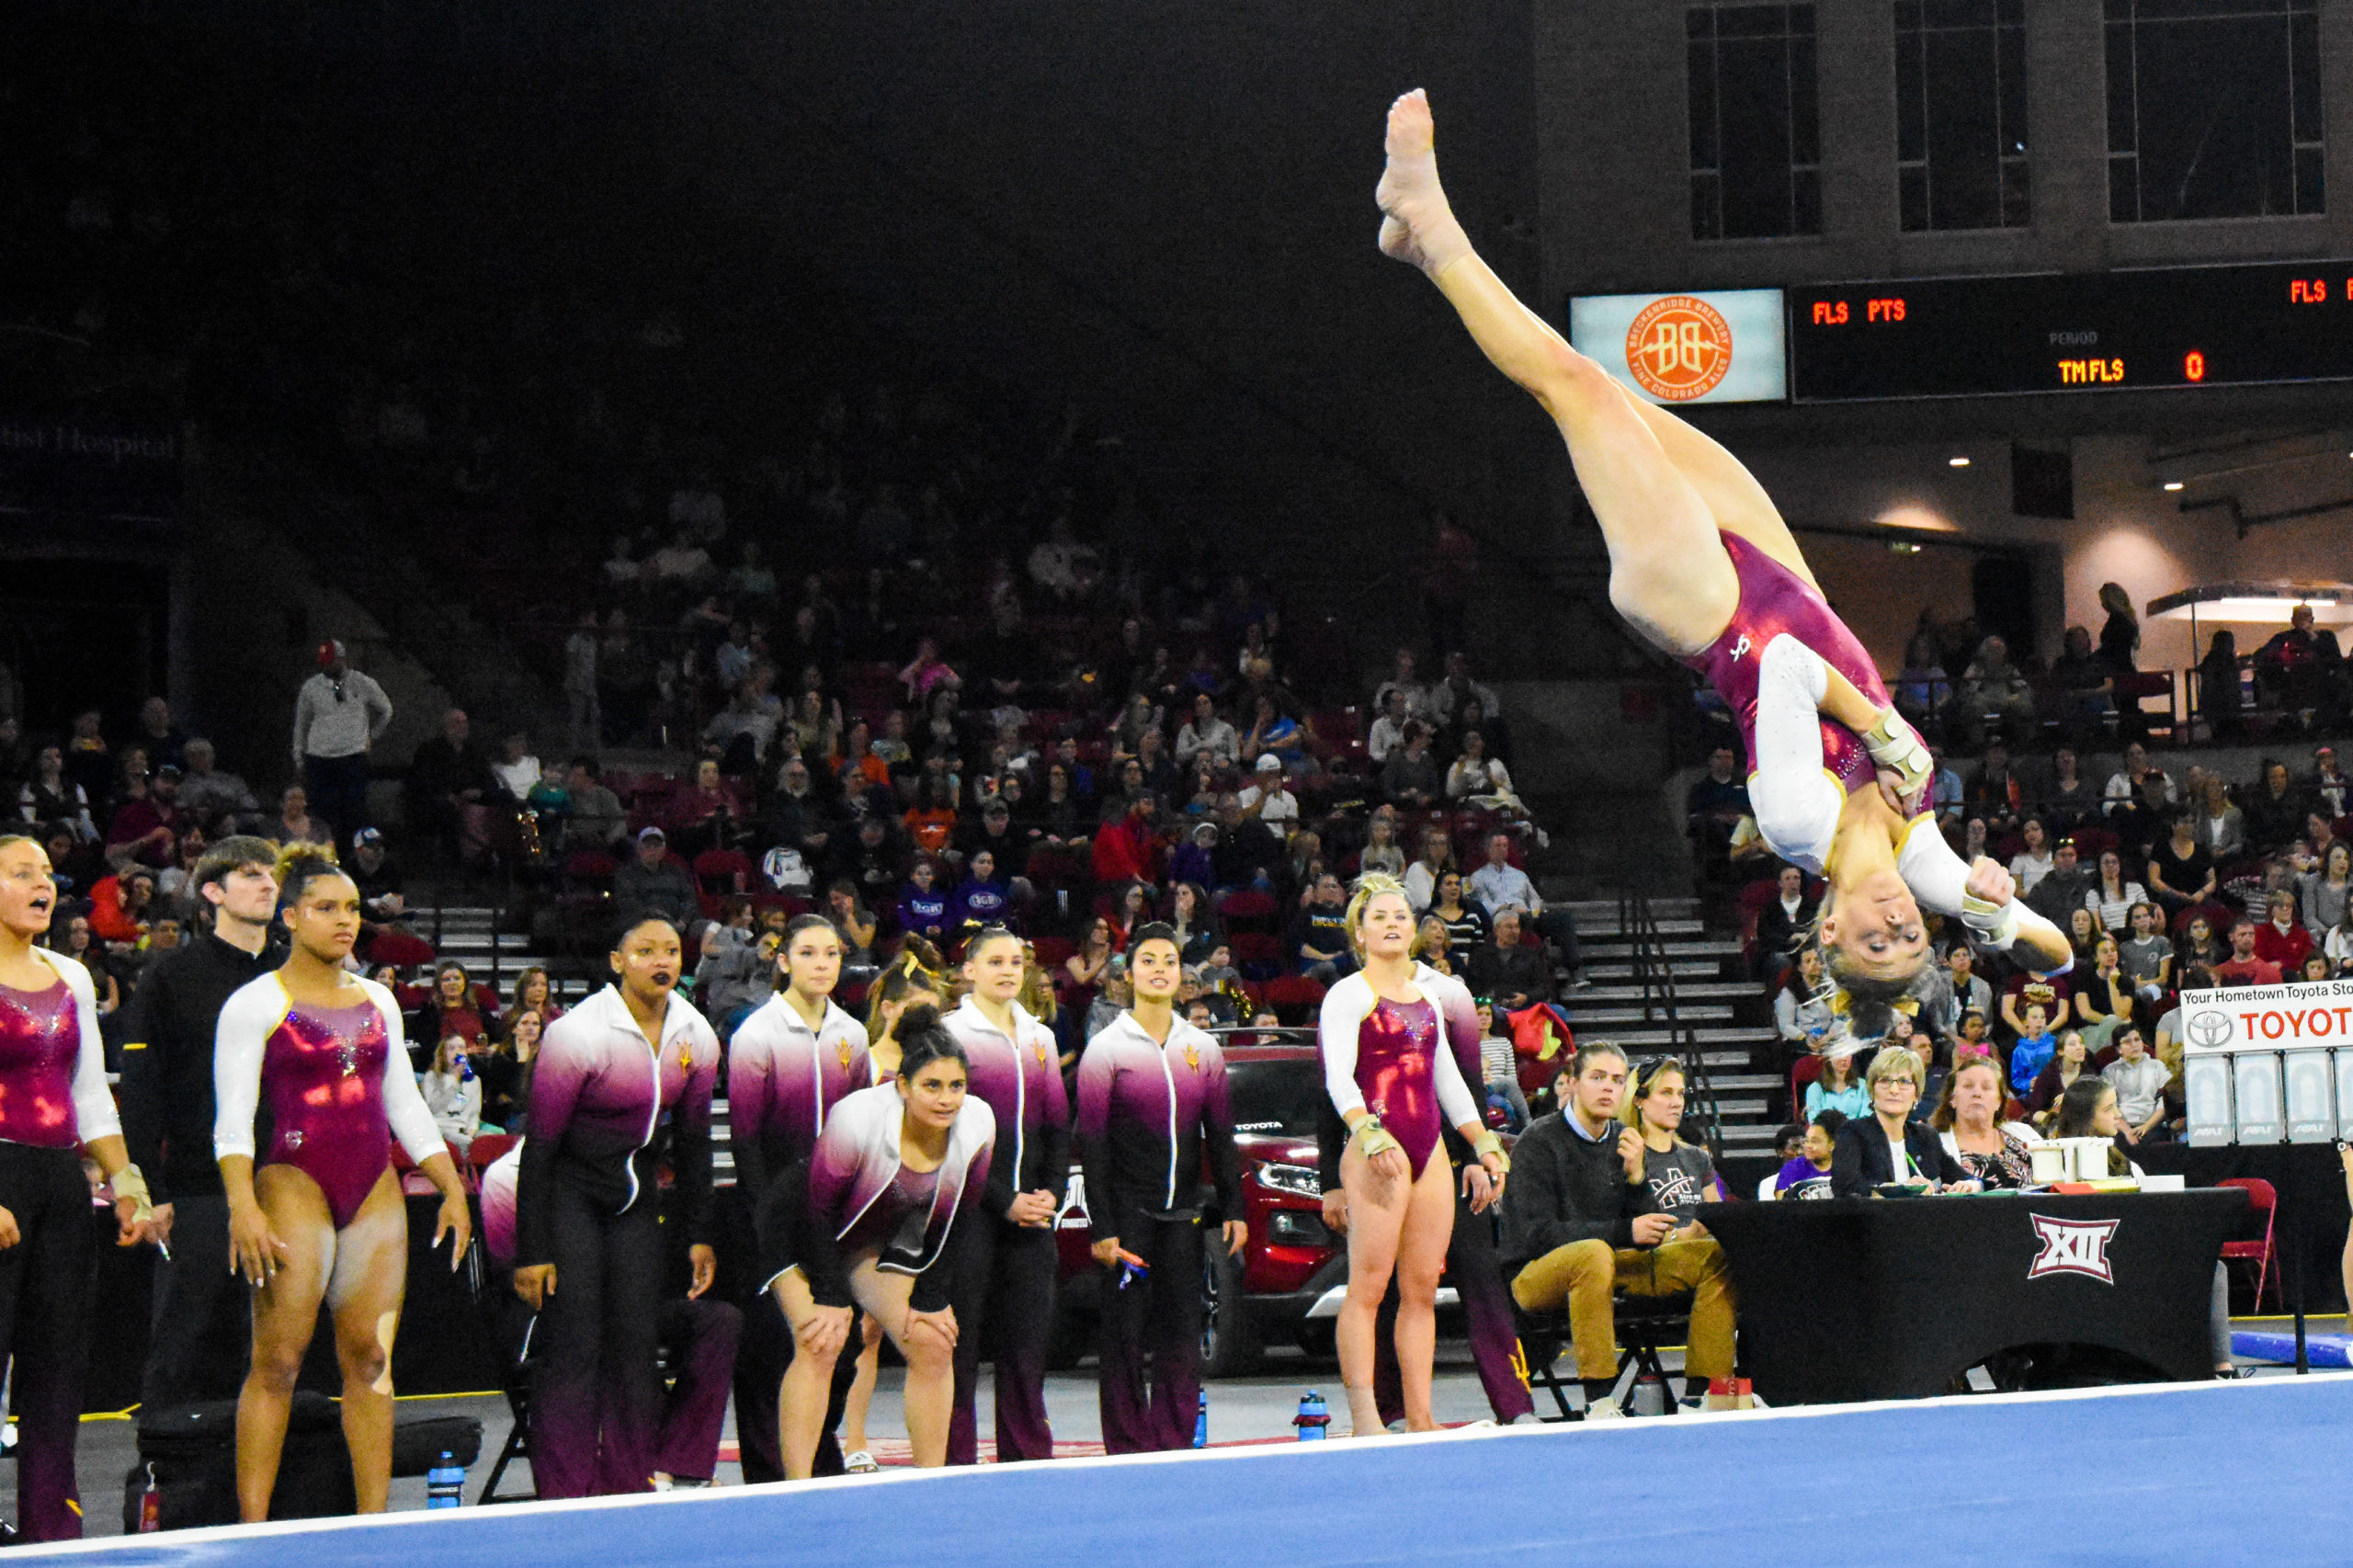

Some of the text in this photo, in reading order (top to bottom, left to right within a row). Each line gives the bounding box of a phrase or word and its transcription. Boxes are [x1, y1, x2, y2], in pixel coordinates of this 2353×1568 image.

[2291, 278, 2326, 303] FLS
[1695, 301, 1730, 345] BREWERY
[1813, 301, 1849, 324] FLS
[1867, 298, 1906, 323] PTS
[2049, 331, 2098, 346] PERIOD
[1631, 358, 1728, 399] FINE COLORADO ALES
[2185, 351, 2204, 381] 0
[56, 426, 176, 464] Hospital
[2184, 992, 2211, 1005] Your
[2215, 989, 2284, 1004] Hometown
[2285, 983, 2328, 1000] Toyota
[1234, 1121, 1283, 1131] TOYOTA
[2034, 1221, 2113, 1277] XII
